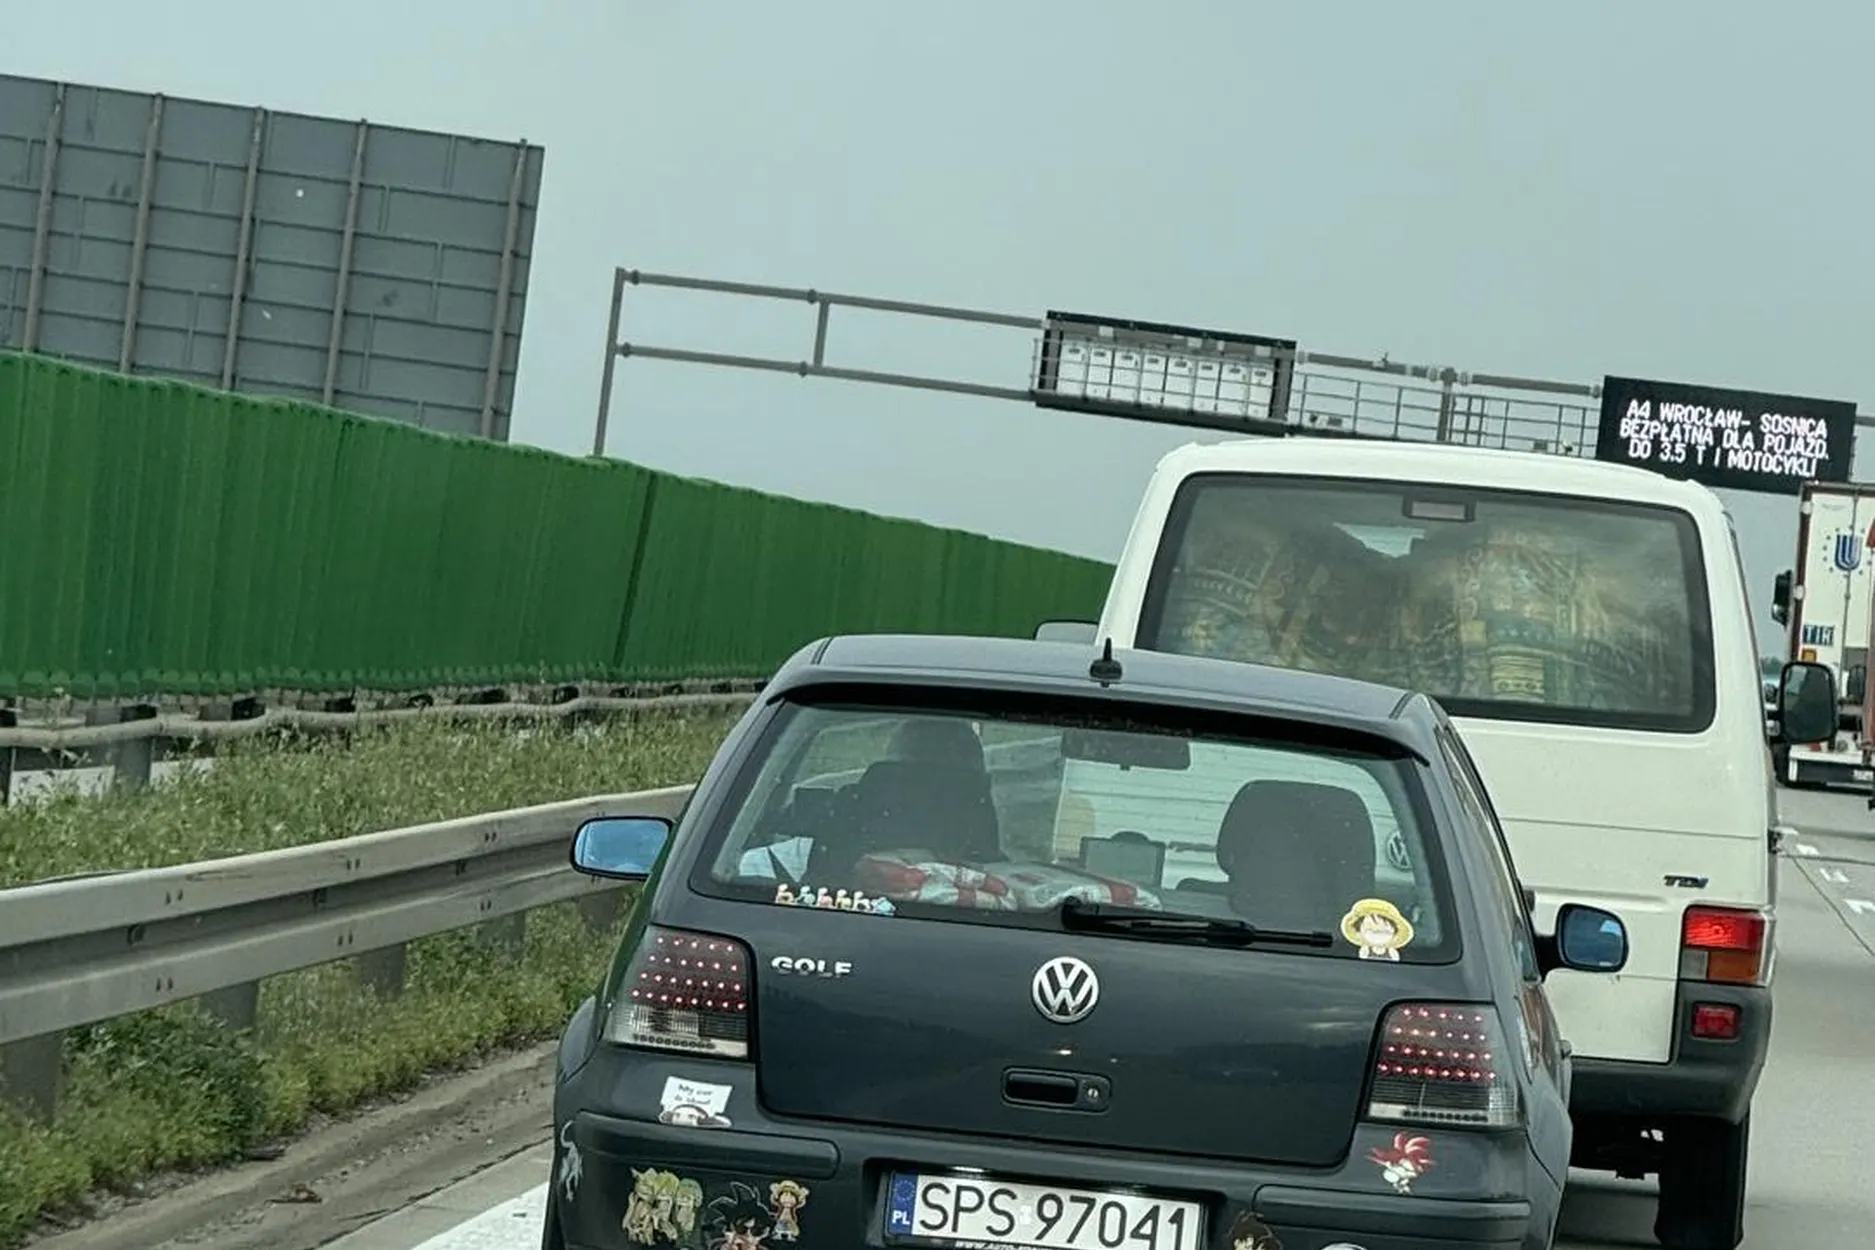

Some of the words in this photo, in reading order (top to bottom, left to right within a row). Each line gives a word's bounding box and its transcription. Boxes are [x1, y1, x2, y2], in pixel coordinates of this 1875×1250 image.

[1627, 399, 1651, 420] A4
[1620, 418, 1714, 447] BEZPŁATNA
[1722, 428, 1755, 451] DLA
[1629, 438, 1651, 460] DO
[1660, 442, 1686, 463] 3.5
[1696, 445, 1706, 466] T
[1728, 448, 1817, 477] MOTOCYKLI
[771, 956, 852, 978] GOLF
[1032, 956, 1099, 1023] VW
[892, 1211, 911, 1225] PL
[919, 1182, 1018, 1237] SPS
